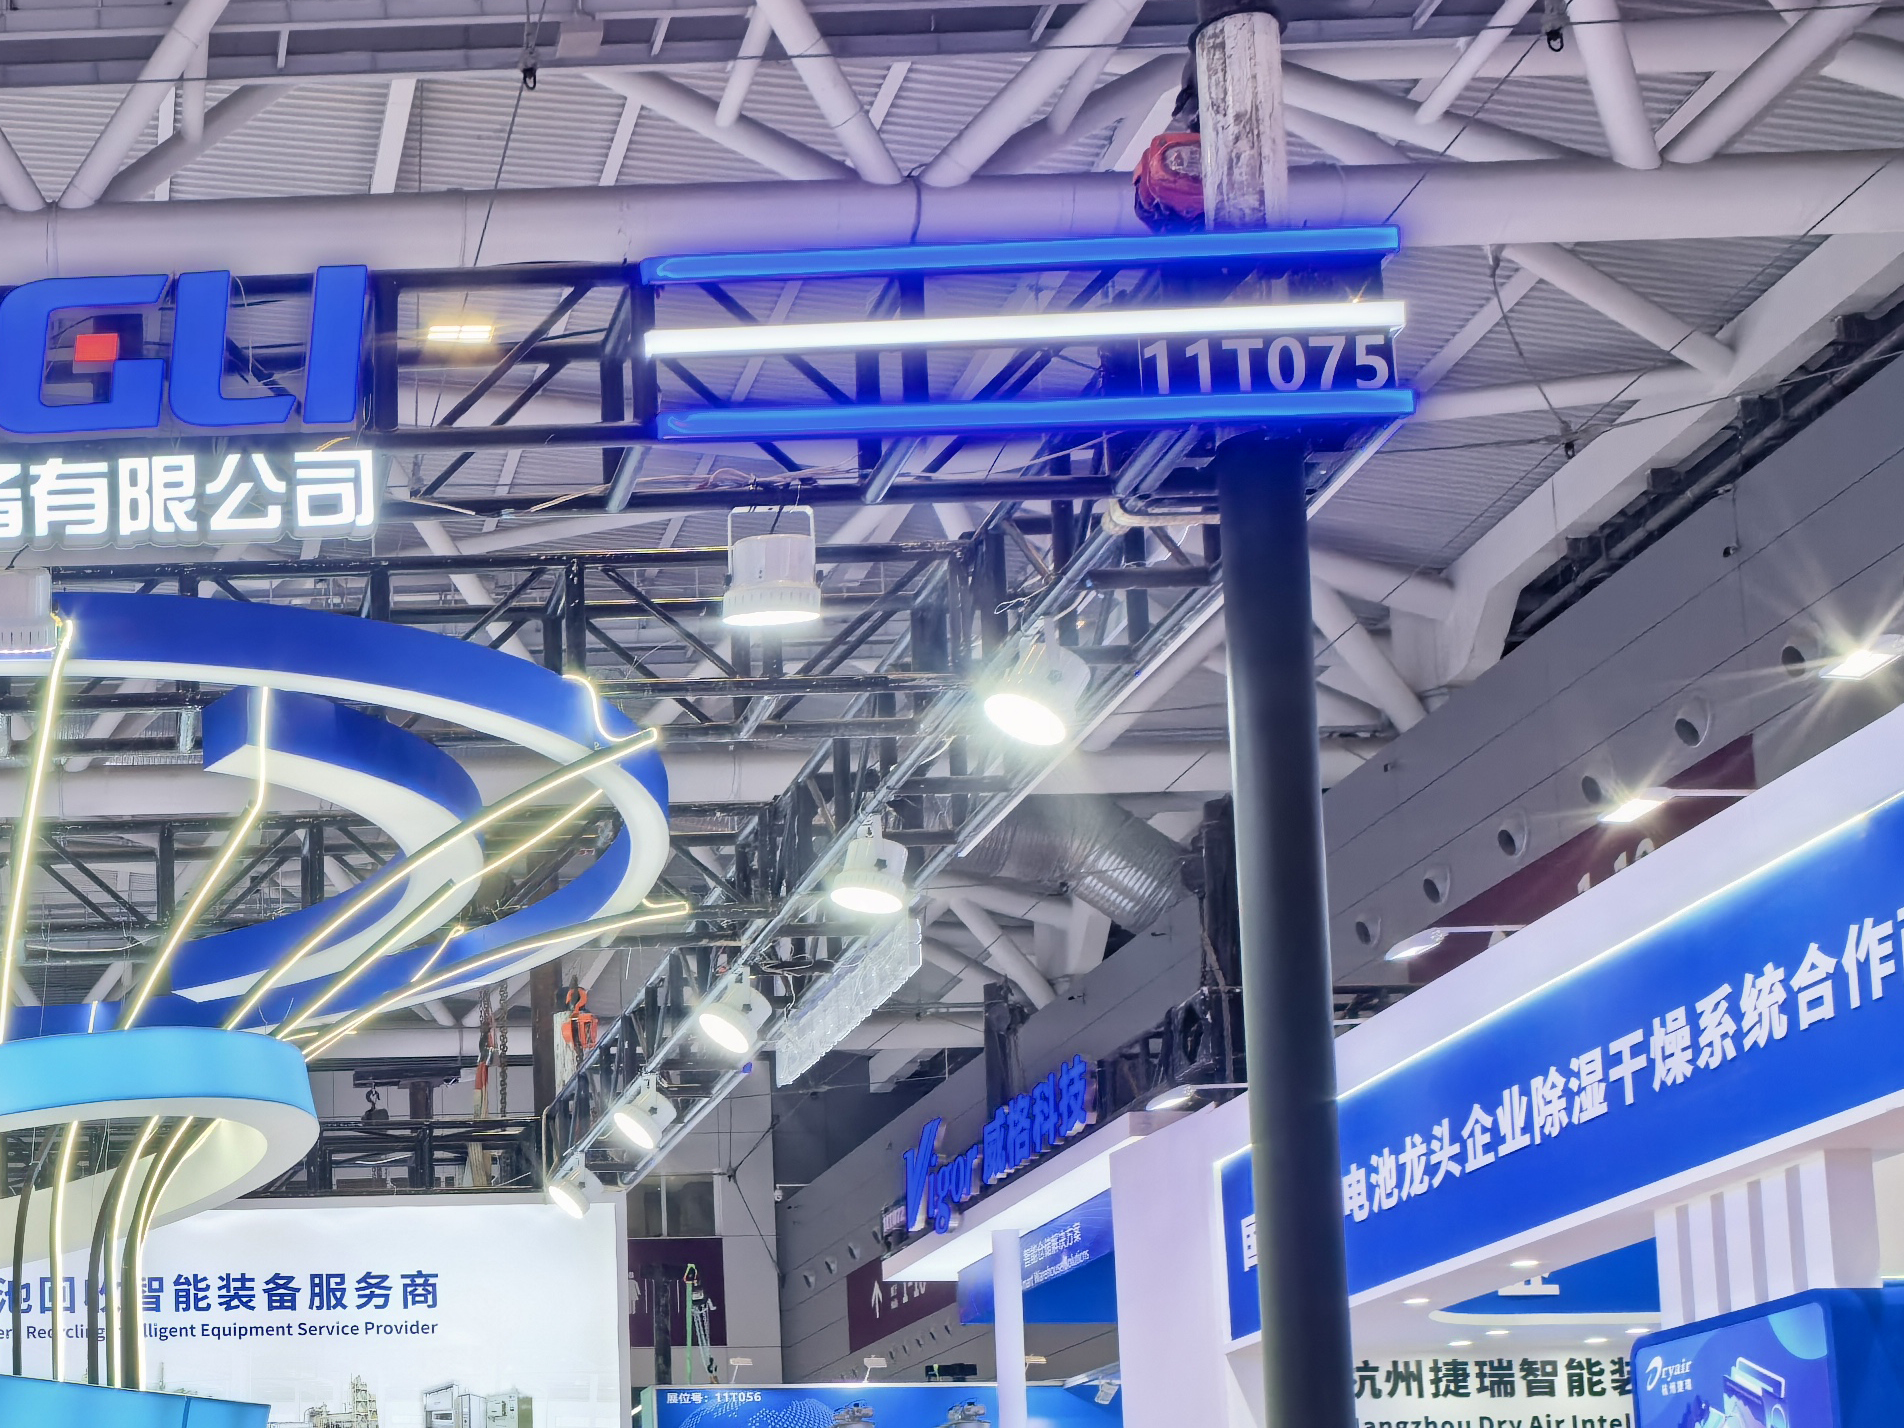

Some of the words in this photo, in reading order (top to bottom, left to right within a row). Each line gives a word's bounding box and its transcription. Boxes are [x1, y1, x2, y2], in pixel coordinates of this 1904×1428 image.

[1142, 333, 1390, 395] 11T075
[1341, 905, 1904, 1224] 电池龙头企业除湿干燥系统合作
[902, 1116, 980, 1235] Vigor
[982, 1053, 1088, 1186] 威格科技
[200, 1322, 294, 1342] Equipment
[297, 1321, 360, 1337] Service
[364, 1320, 439, 1336] Provider
